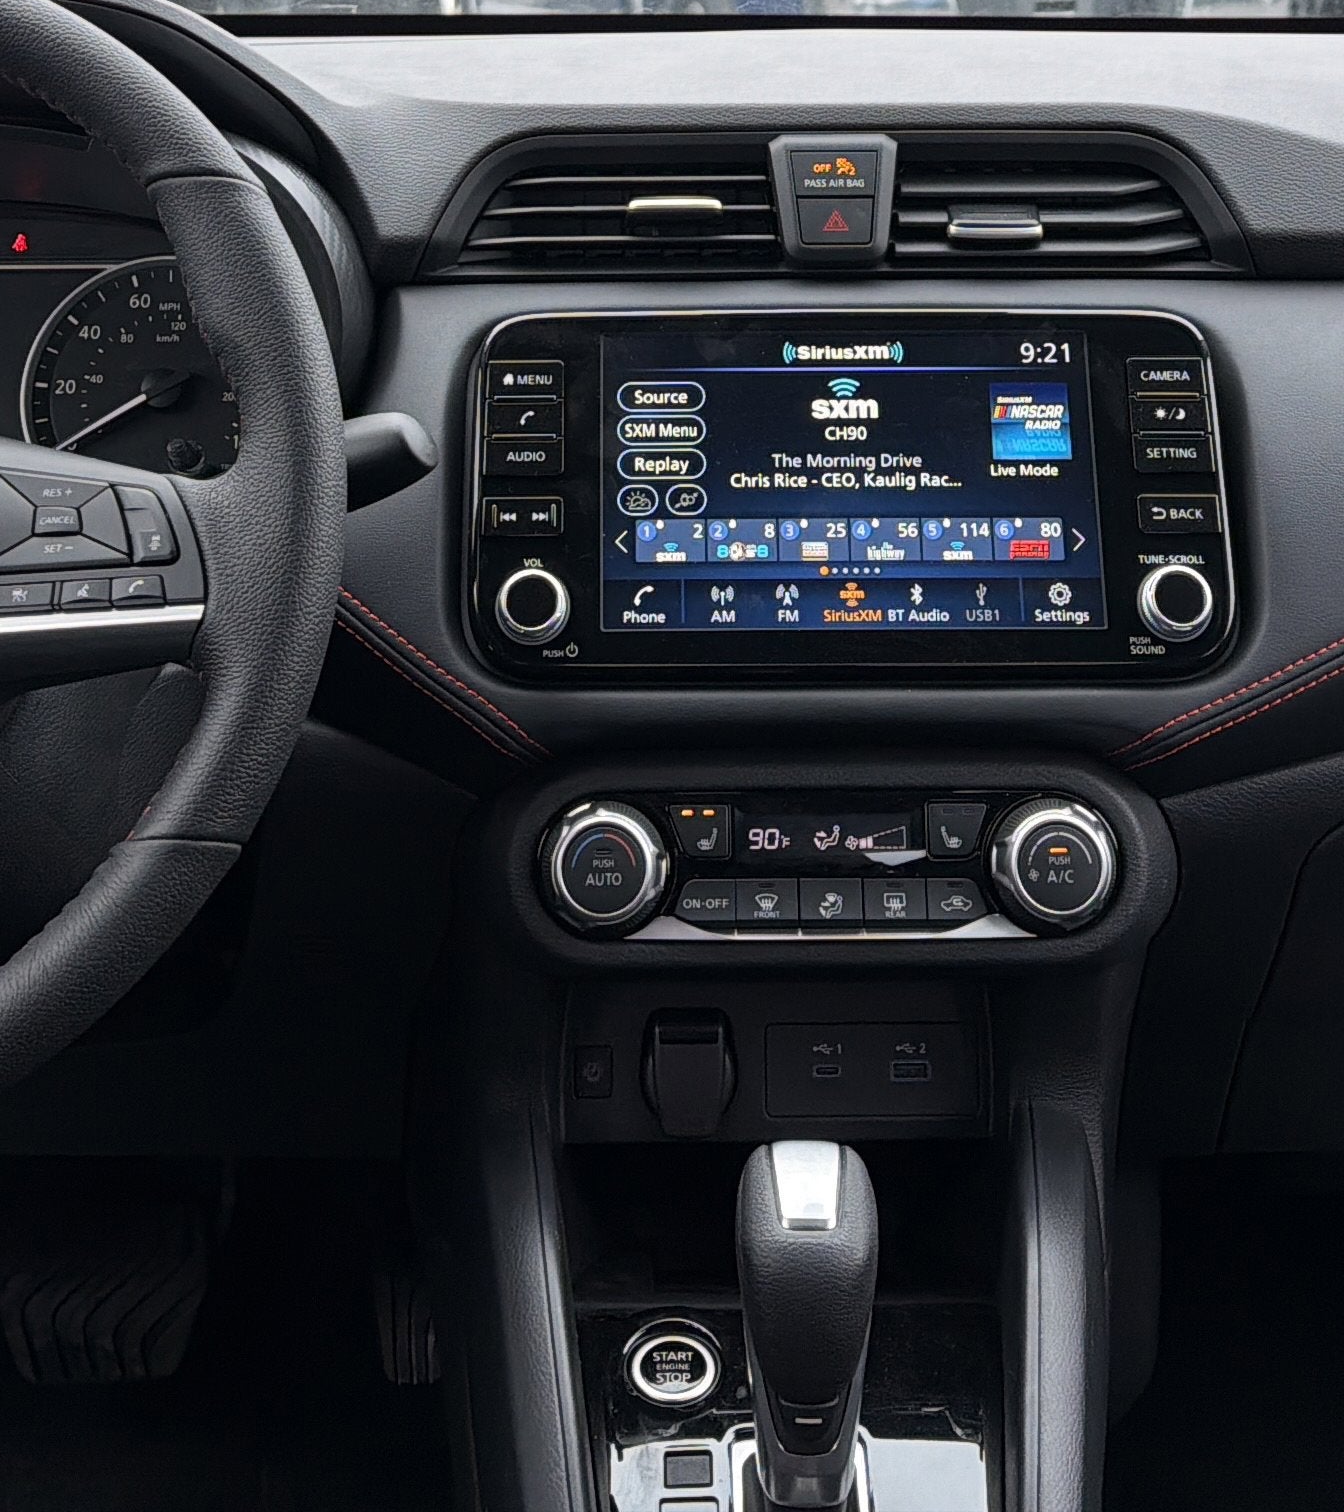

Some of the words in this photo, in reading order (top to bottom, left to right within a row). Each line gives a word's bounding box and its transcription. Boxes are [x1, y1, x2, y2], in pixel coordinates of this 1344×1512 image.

[813, 163, 833, 173] OFF
[804, 178, 827, 188] PASS
[829, 178, 845, 188] AIR
[846, 178, 865, 188] BAG
[129, 294, 151, 309] 60
[159, 302, 181, 311] MPH
[170, 321, 187, 331] 120
[78, 325, 101, 340] 40
[120, 333, 134, 343] 80
[156, 334, 180, 343] km/h
[1020, 342, 1071, 363] 9:21
[89, 374, 103, 384] 40
[517, 374, 553, 385] MENU
[1140, 370, 1190, 381] CAMERA
[55, 379, 76, 395] 20
[634, 390, 688, 404] Source
[1010, 404, 1064, 418] NASCAR
[624, 423, 656, 437] SXM
[659, 423, 697, 437] Menu
[1025, 420, 1061, 430] RADIO
[825, 426, 867, 440] CH90
[506, 451, 546, 462] AUDIO
[1146, 448, 1197, 459] SETTING
[634, 456, 690, 475] Replay
[771, 453, 802, 467] The
[806, 453, 876, 471] Morning
[880, 453, 923, 467] Drive
[990, 463, 1016, 477] Live
[1020, 463, 1060, 477] Mode
[730, 472, 770, 488] Chris
[774, 472, 807, 488] Rice
[821, 473, 860, 490] CEO,
[864, 472, 916, 490] Kaulig
[920, 473, 963, 488] Rac...
[43, 488, 61, 497] RES
[1169, 508, 1204, 520] BACK
[39, 515, 76, 526] CANCEL
[692, 523, 704, 538] 2
[764, 523, 776, 538] 8
[826, 523, 847, 538] 25
[897, 522, 919, 538] 56
[960, 522, 990, 538] 114
[1040, 522, 1062, 538] 80
[43, 544, 62, 553] SET
[523, 558, 544, 568] VOL
[623, 610, 666, 623] Phone
[710, 610, 736, 623] AM
[777, 610, 799, 622] FM
[823, 609, 882, 622] SiriusXM
[887, 610, 905, 622] BT
[908, 609, 950, 622] Audio
[966, 610, 1000, 622] USB1
[1034, 609, 1090, 624] Settings
[1129, 636, 1151, 645] PUSH
[542, 648, 564, 658] PUSH
[1130, 645, 1166, 655] SOUND
[592, 859, 614, 868] PUSH
[1049, 856, 1071, 865] PUSH
[585, 872, 623, 886] AUTO
[1047, 869, 1074, 884] A/C
[754, 911, 780, 919] FRONT
[885, 911, 906, 919] REAR
[652, 1351, 694, 1362] START
[656, 1363, 691, 1371] ENGINE
[656, 1372, 691, 1383] STOP
